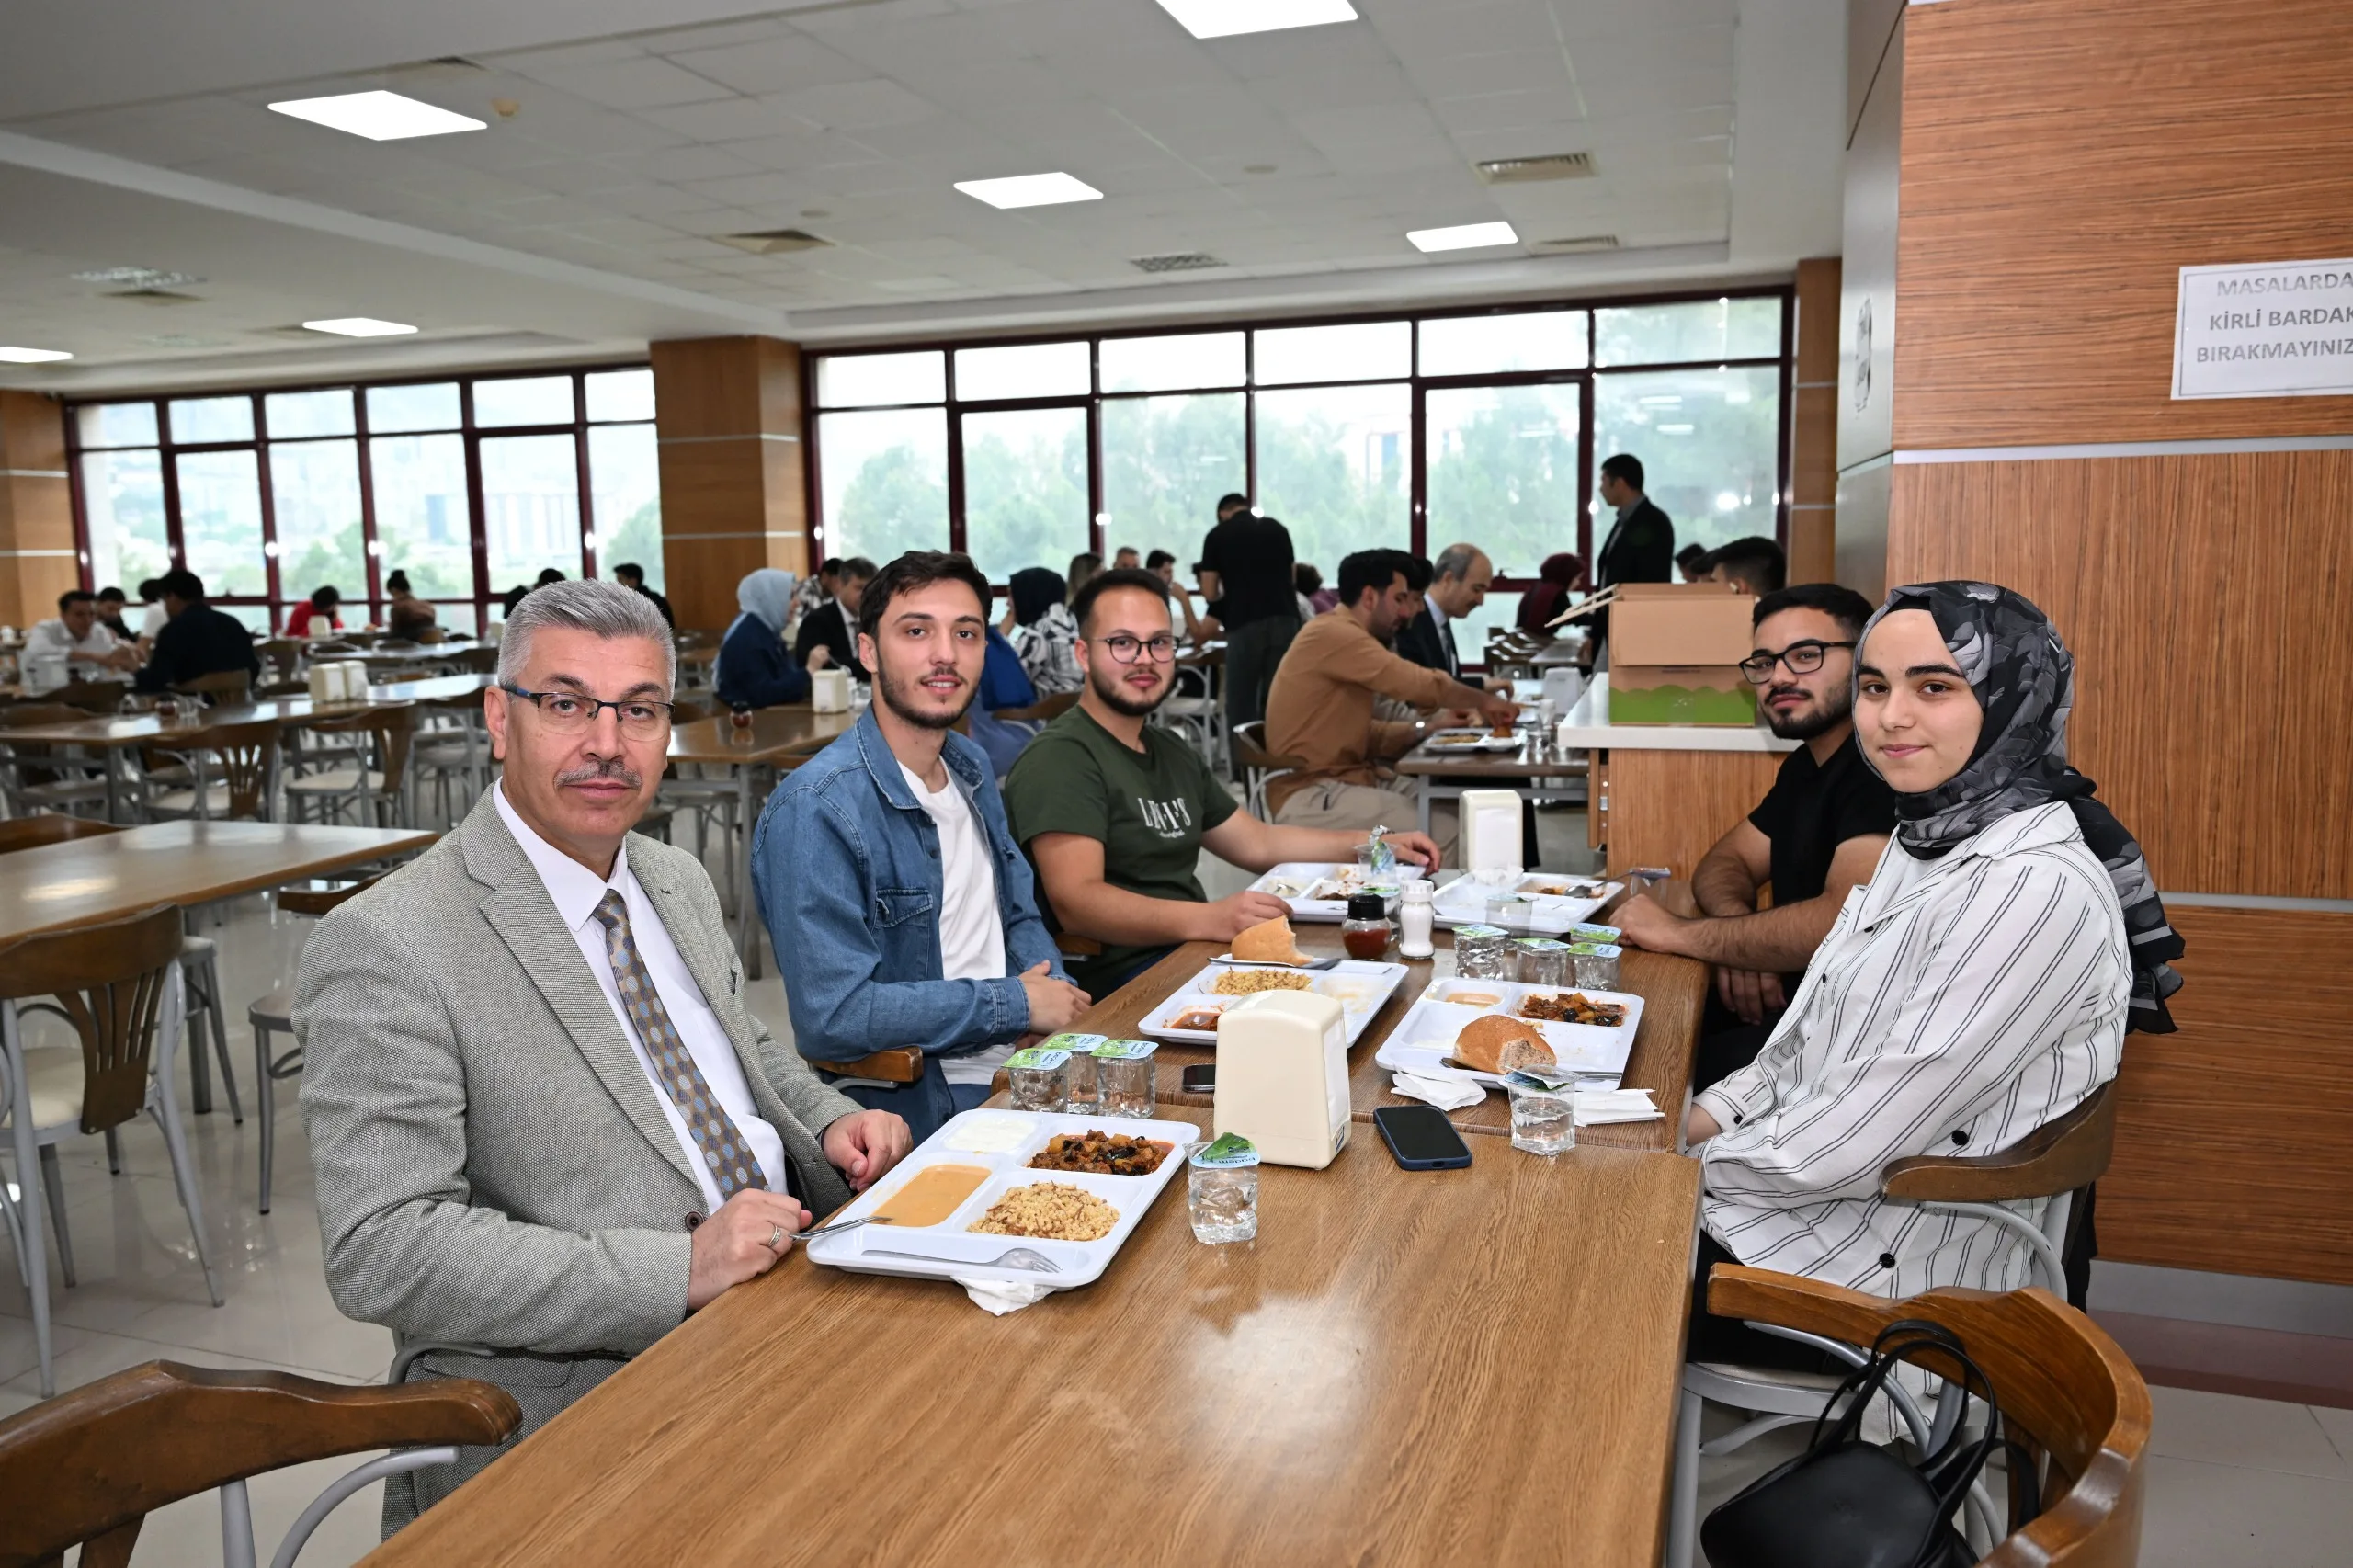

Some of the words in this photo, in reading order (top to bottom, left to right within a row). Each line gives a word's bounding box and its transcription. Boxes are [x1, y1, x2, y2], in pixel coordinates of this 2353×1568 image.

[2216, 272, 2353, 296] MASALARDA
[2210, 310, 2260, 330] KİRLİ
[2268, 307, 2353, 326] BARDAK
[2197, 339, 2353, 362] BIRAKMAYINIZ
